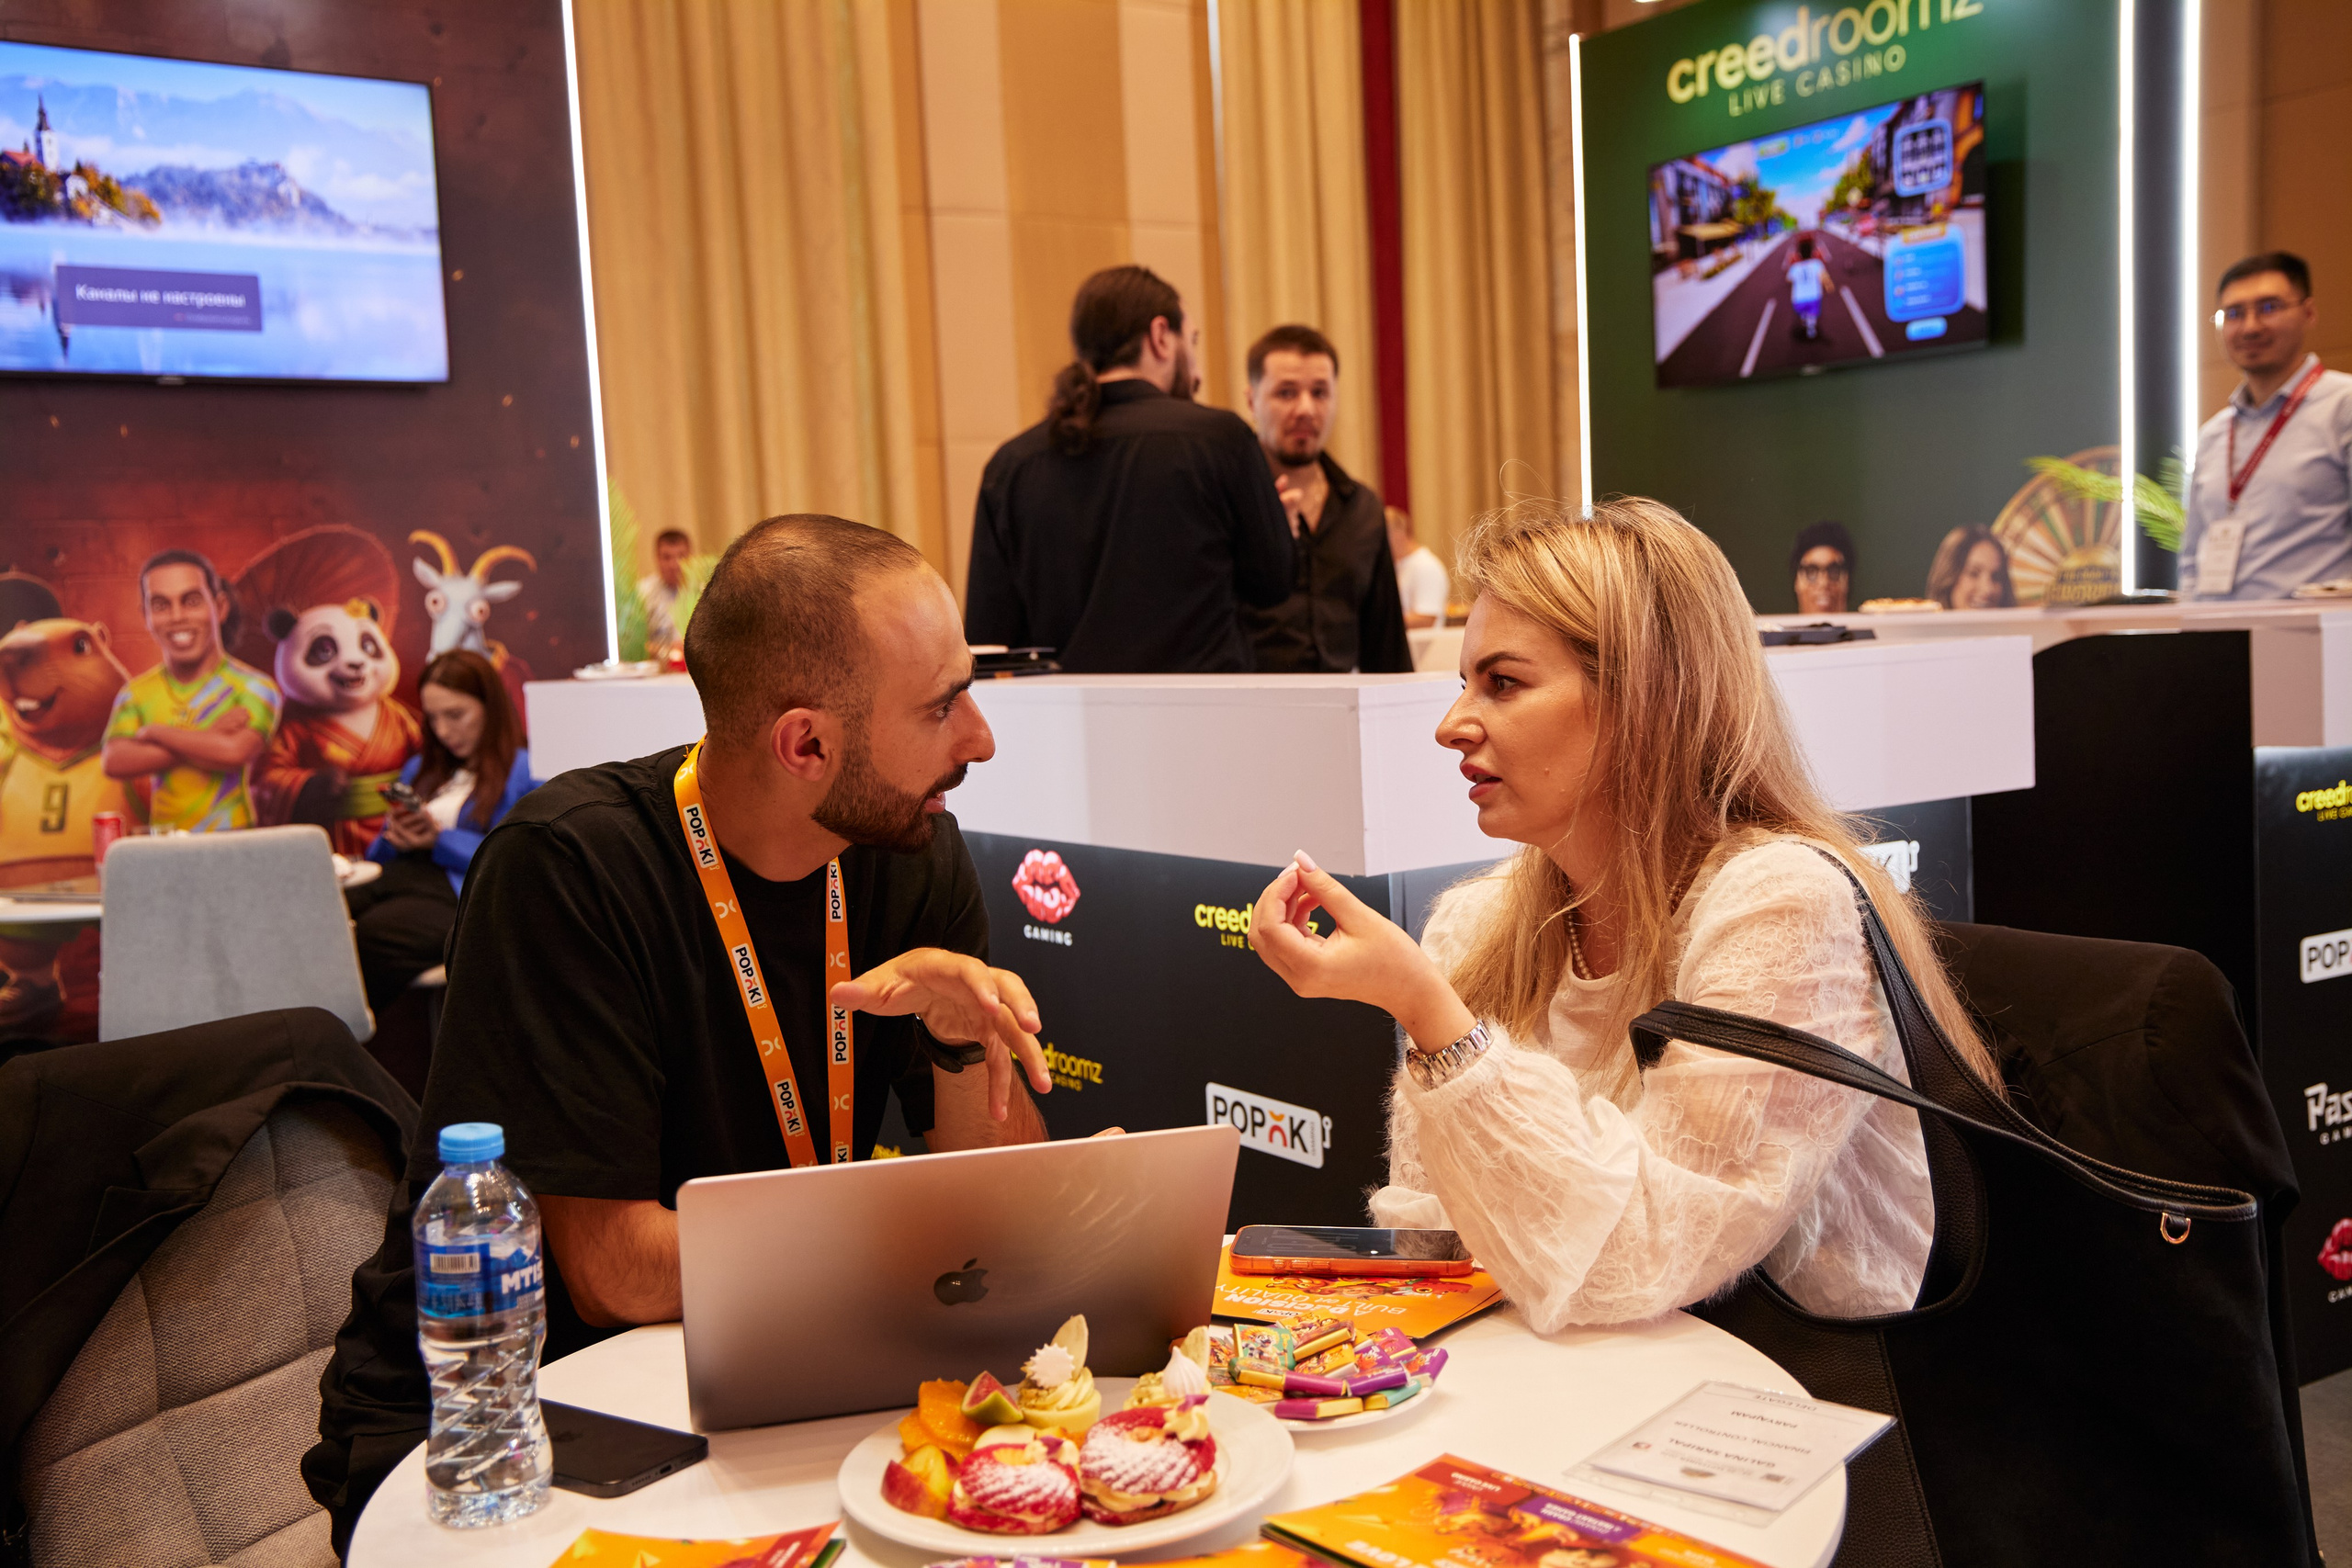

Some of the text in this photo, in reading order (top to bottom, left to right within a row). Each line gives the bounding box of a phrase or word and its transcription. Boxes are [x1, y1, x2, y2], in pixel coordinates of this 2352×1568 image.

[1728, 44, 1906, 117] LIVE CASINO
[75, 284, 138, 303] Каналы
[140, 289, 161, 304] не
[41, 783, 68, 832] 9
[1023, 923, 1073, 946] GAMING
[1220, 932, 1245, 949] LIVE
[2306, 940, 2352, 972] POP
[1216, 1283, 1310, 1303] QUALITY
[1336, 1301, 1407, 1314] BUILT
[1353, 1308, 1374, 1316] A
[1754, 1394, 1817, 1412] DELEGATE
[1668, 1438, 1720, 1456] SKRIPAL
[1674, 1420, 1812, 1455] FINANCIAL CONTROLLER
[1724, 1452, 1776, 1468] GALINA
